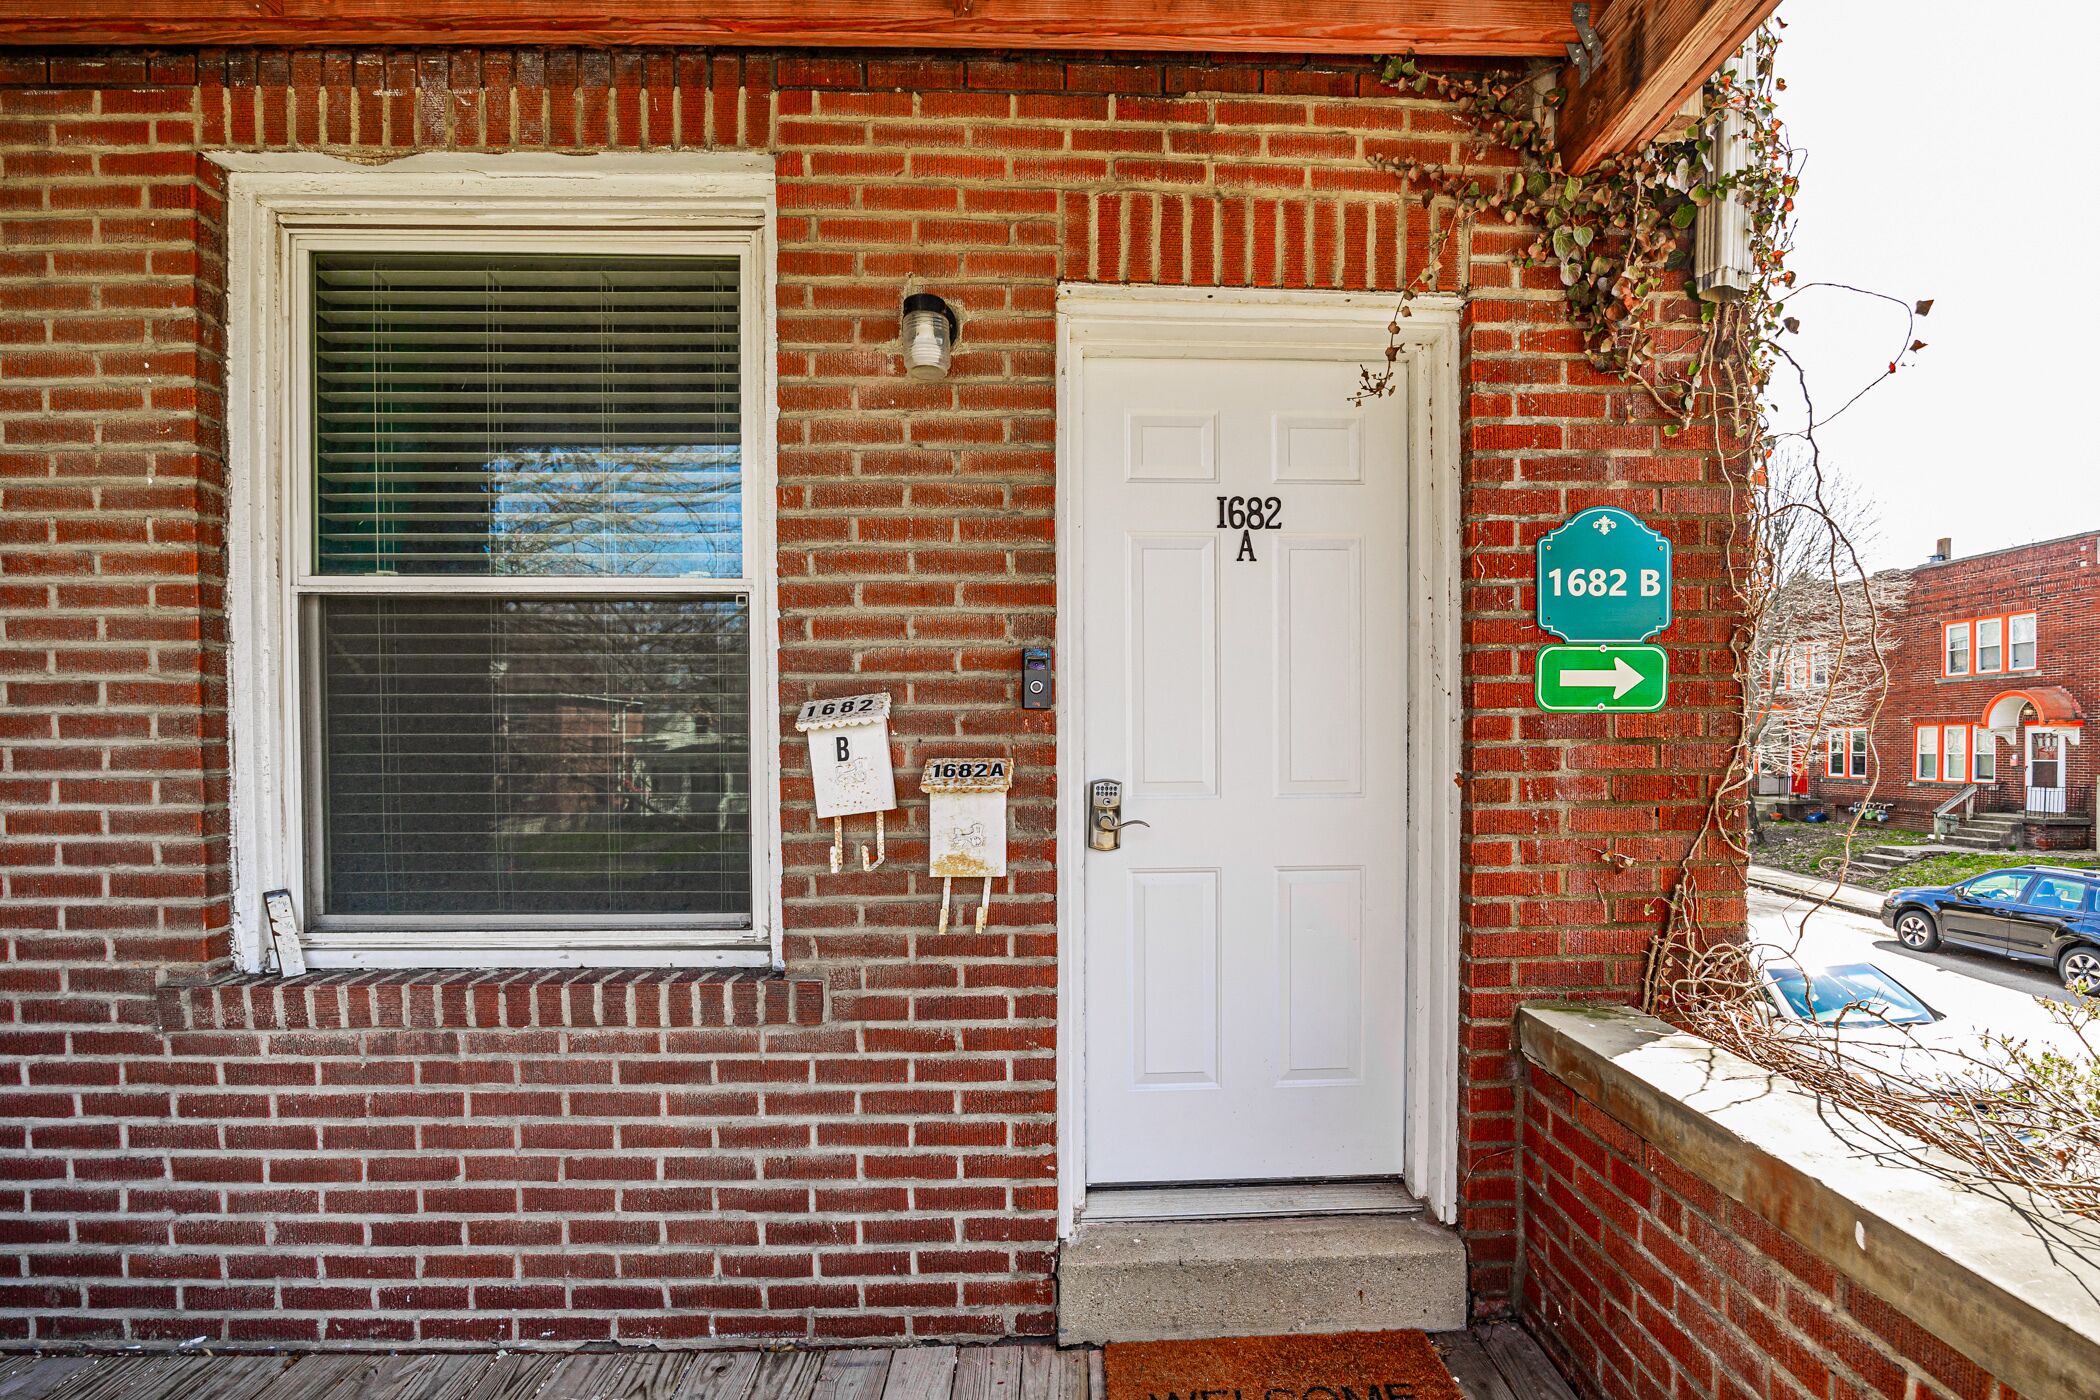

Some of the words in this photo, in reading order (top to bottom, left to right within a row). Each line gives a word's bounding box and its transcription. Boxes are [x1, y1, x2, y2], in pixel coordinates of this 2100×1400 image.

[1216, 496, 1282, 530] 1682
[1236, 529, 1257, 561] A
[1548, 568, 1627, 597] 1682
[1640, 569, 1661, 597] B
[807, 699, 873, 717] 1682
[836, 736, 850, 762] B
[933, 763, 1005, 778] 1682A
